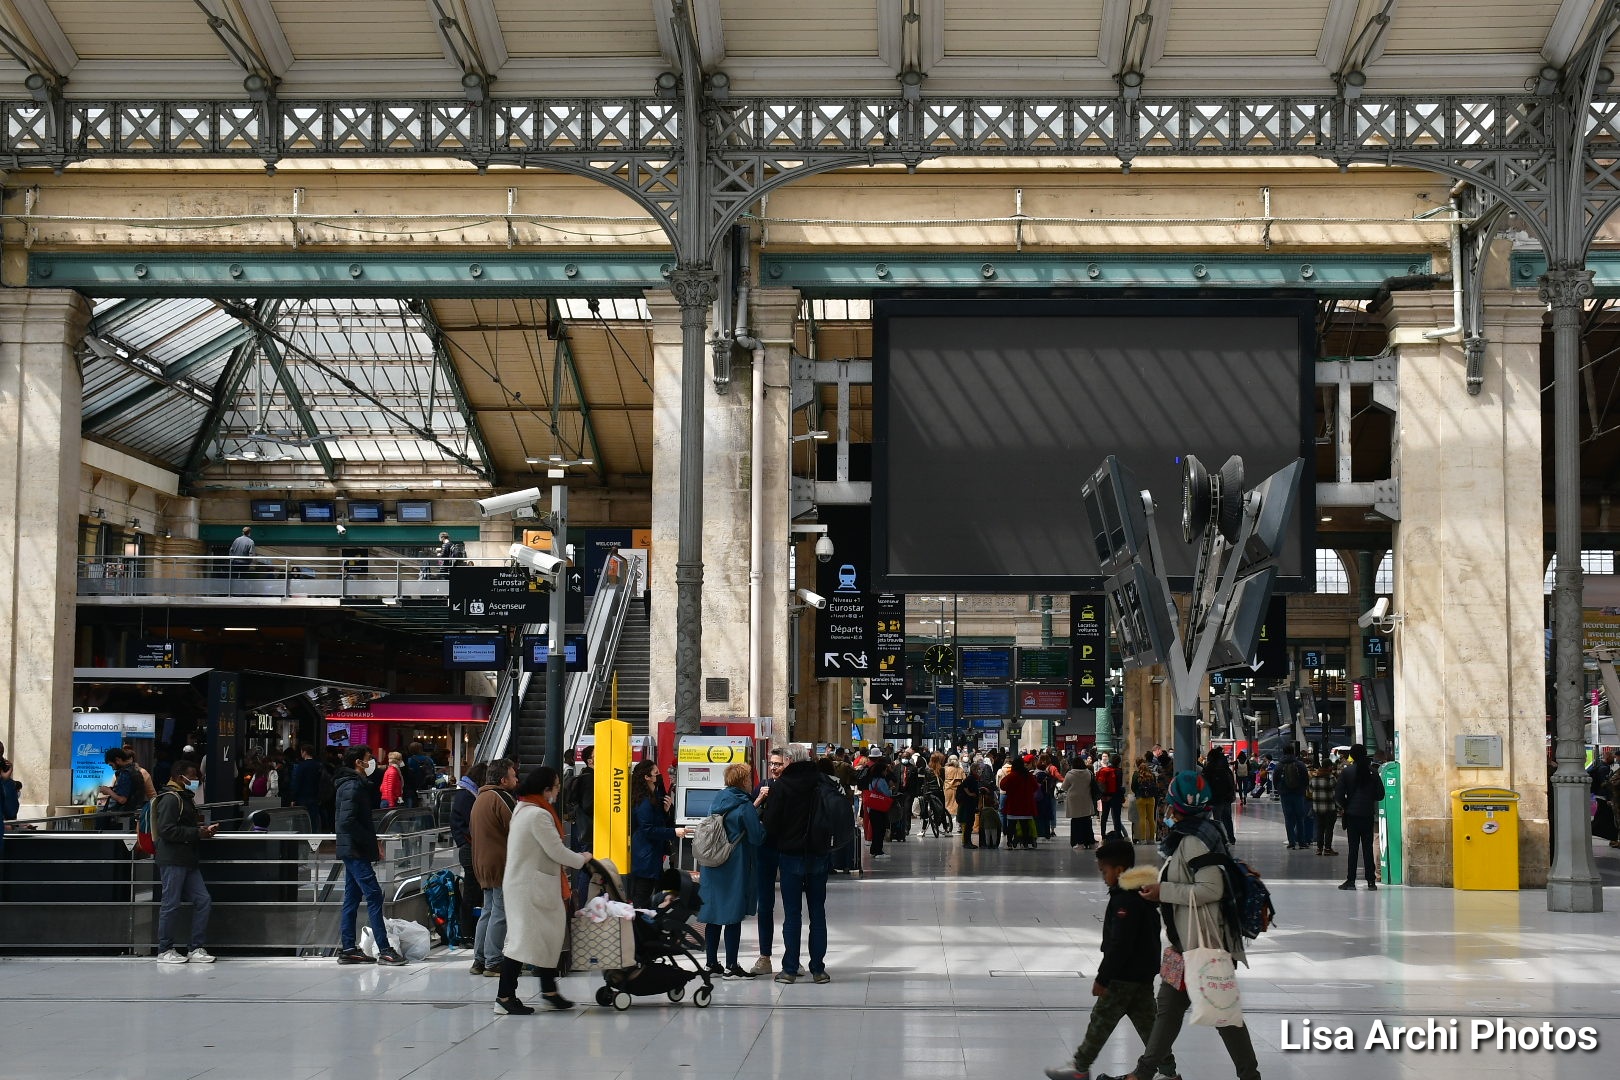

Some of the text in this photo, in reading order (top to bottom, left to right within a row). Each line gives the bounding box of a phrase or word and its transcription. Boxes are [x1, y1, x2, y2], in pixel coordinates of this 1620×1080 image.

[830, 625, 862, 634] Départs
[1083, 646, 1093, 658] P
[1368, 642, 1382, 653] 14
[1305, 656, 1318, 666] 13
[74, 722, 118, 730] Photomaton
[258, 713, 274, 731] PAUL
[78, 744, 100, 756] Office
[613, 767, 624, 813] Alarme
